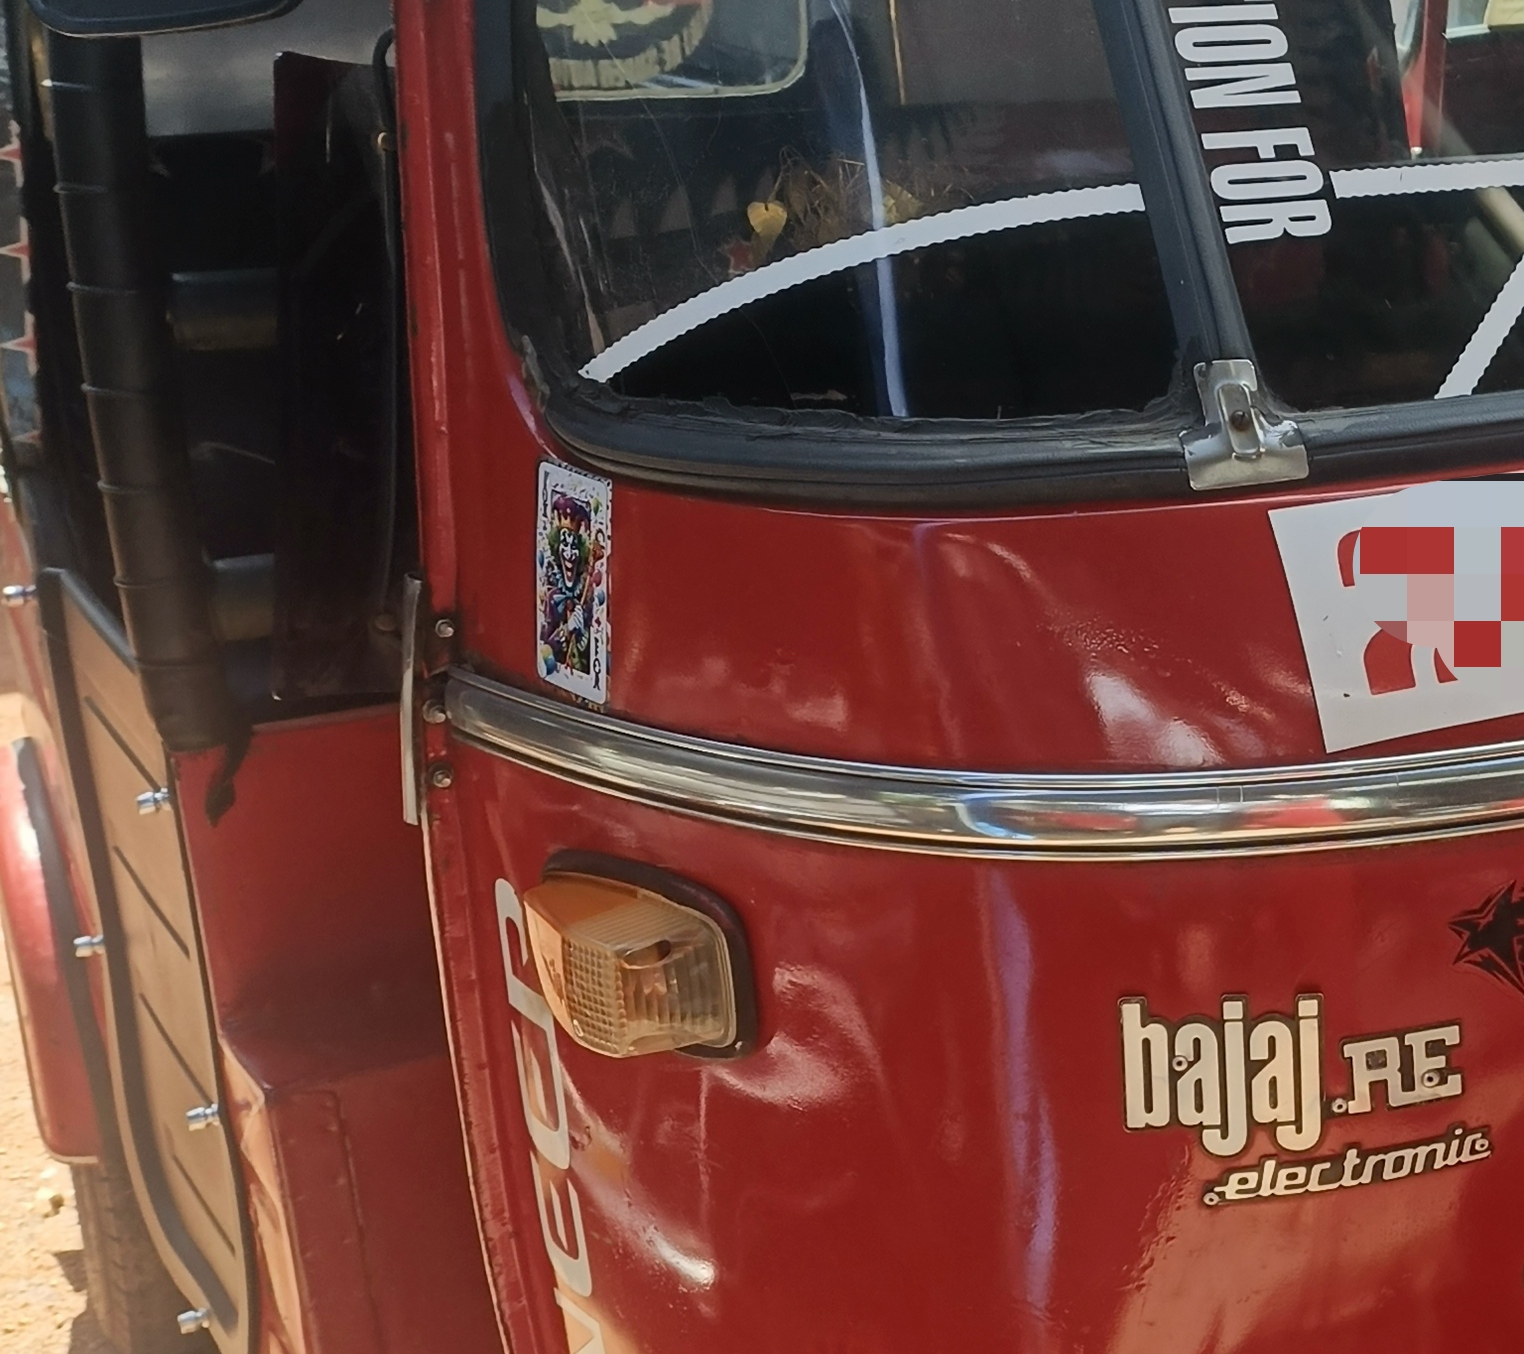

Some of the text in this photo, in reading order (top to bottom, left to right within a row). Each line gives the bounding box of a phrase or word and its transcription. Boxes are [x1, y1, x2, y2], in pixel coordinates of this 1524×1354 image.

[1200, 125, 1334, 246] FOR
[1120, 997, 1323, 1158] bajaj
[1211, 1129, 1492, 1203] electronic
